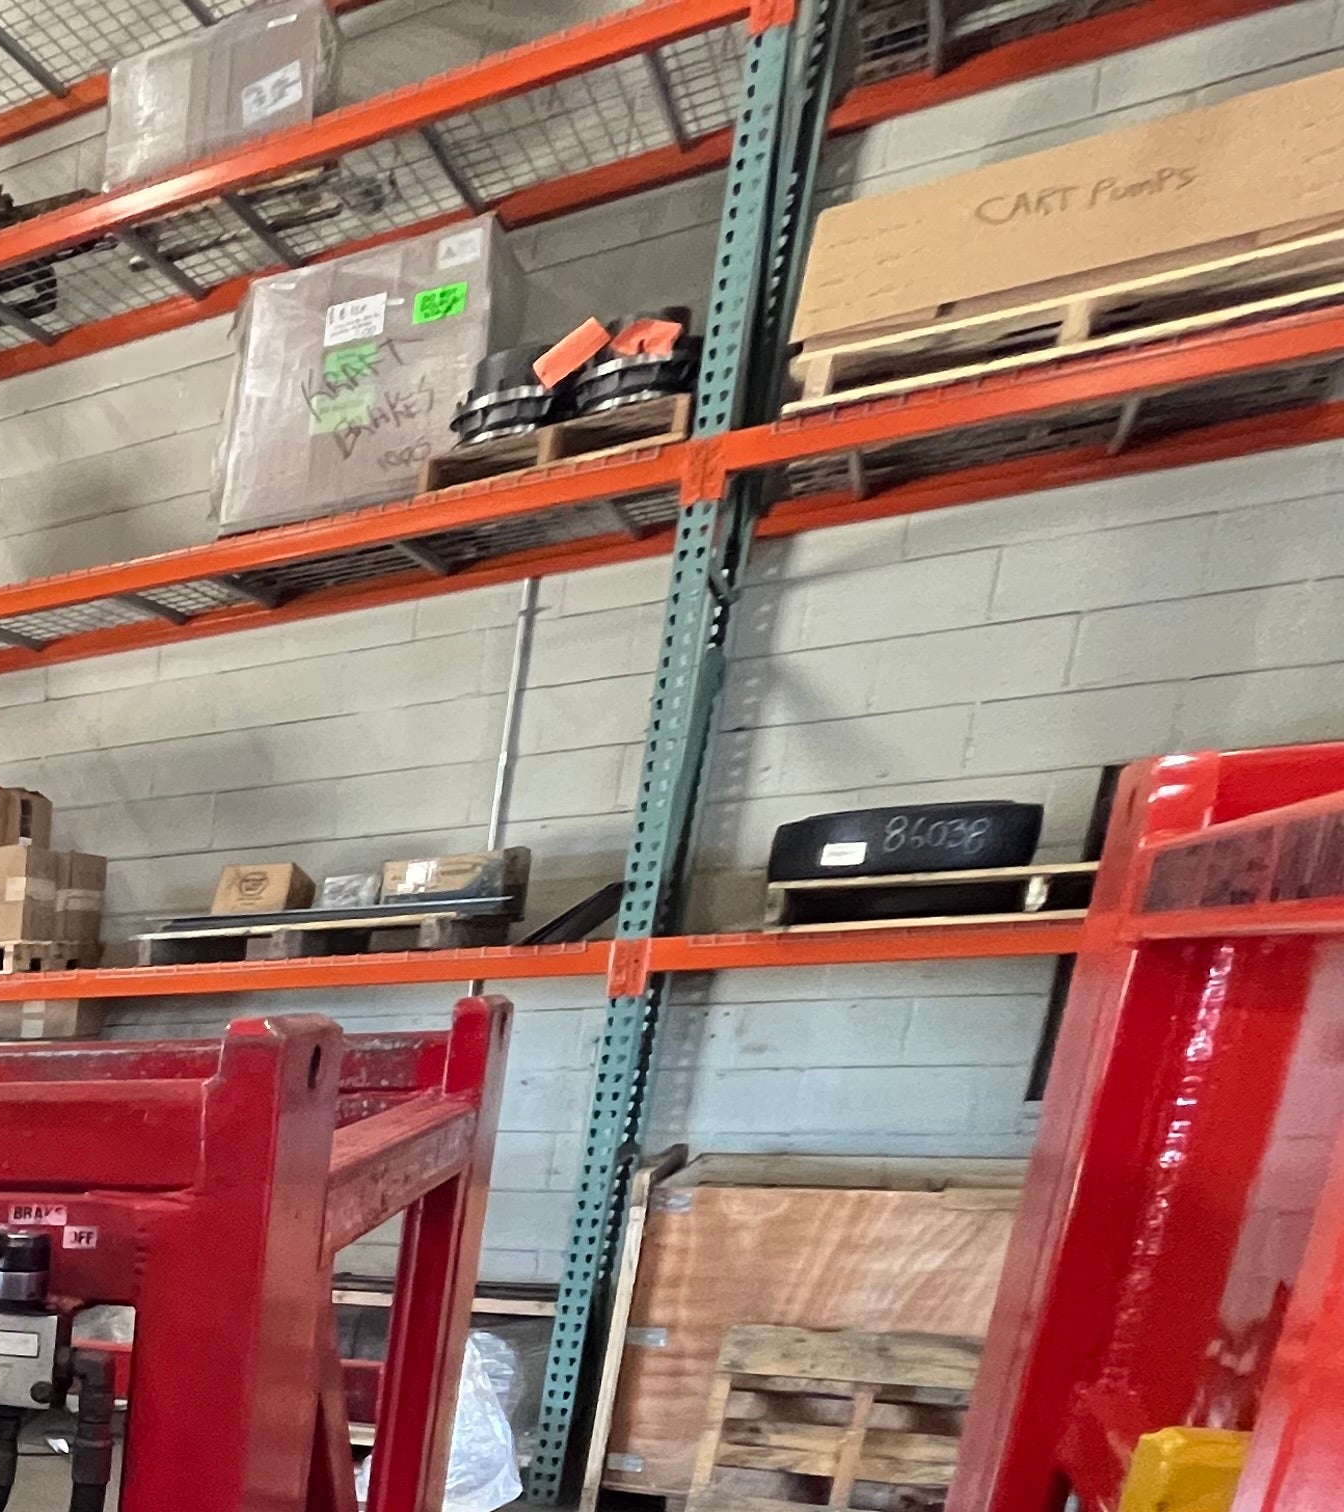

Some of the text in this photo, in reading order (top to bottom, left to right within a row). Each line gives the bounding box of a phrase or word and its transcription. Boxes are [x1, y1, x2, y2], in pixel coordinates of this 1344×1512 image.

[975, 185, 1079, 225] CART
[302, 337, 424, 423] KRAFT
[332, 375, 434, 460] BRAKES
[882, 814, 992, 856] 86038
